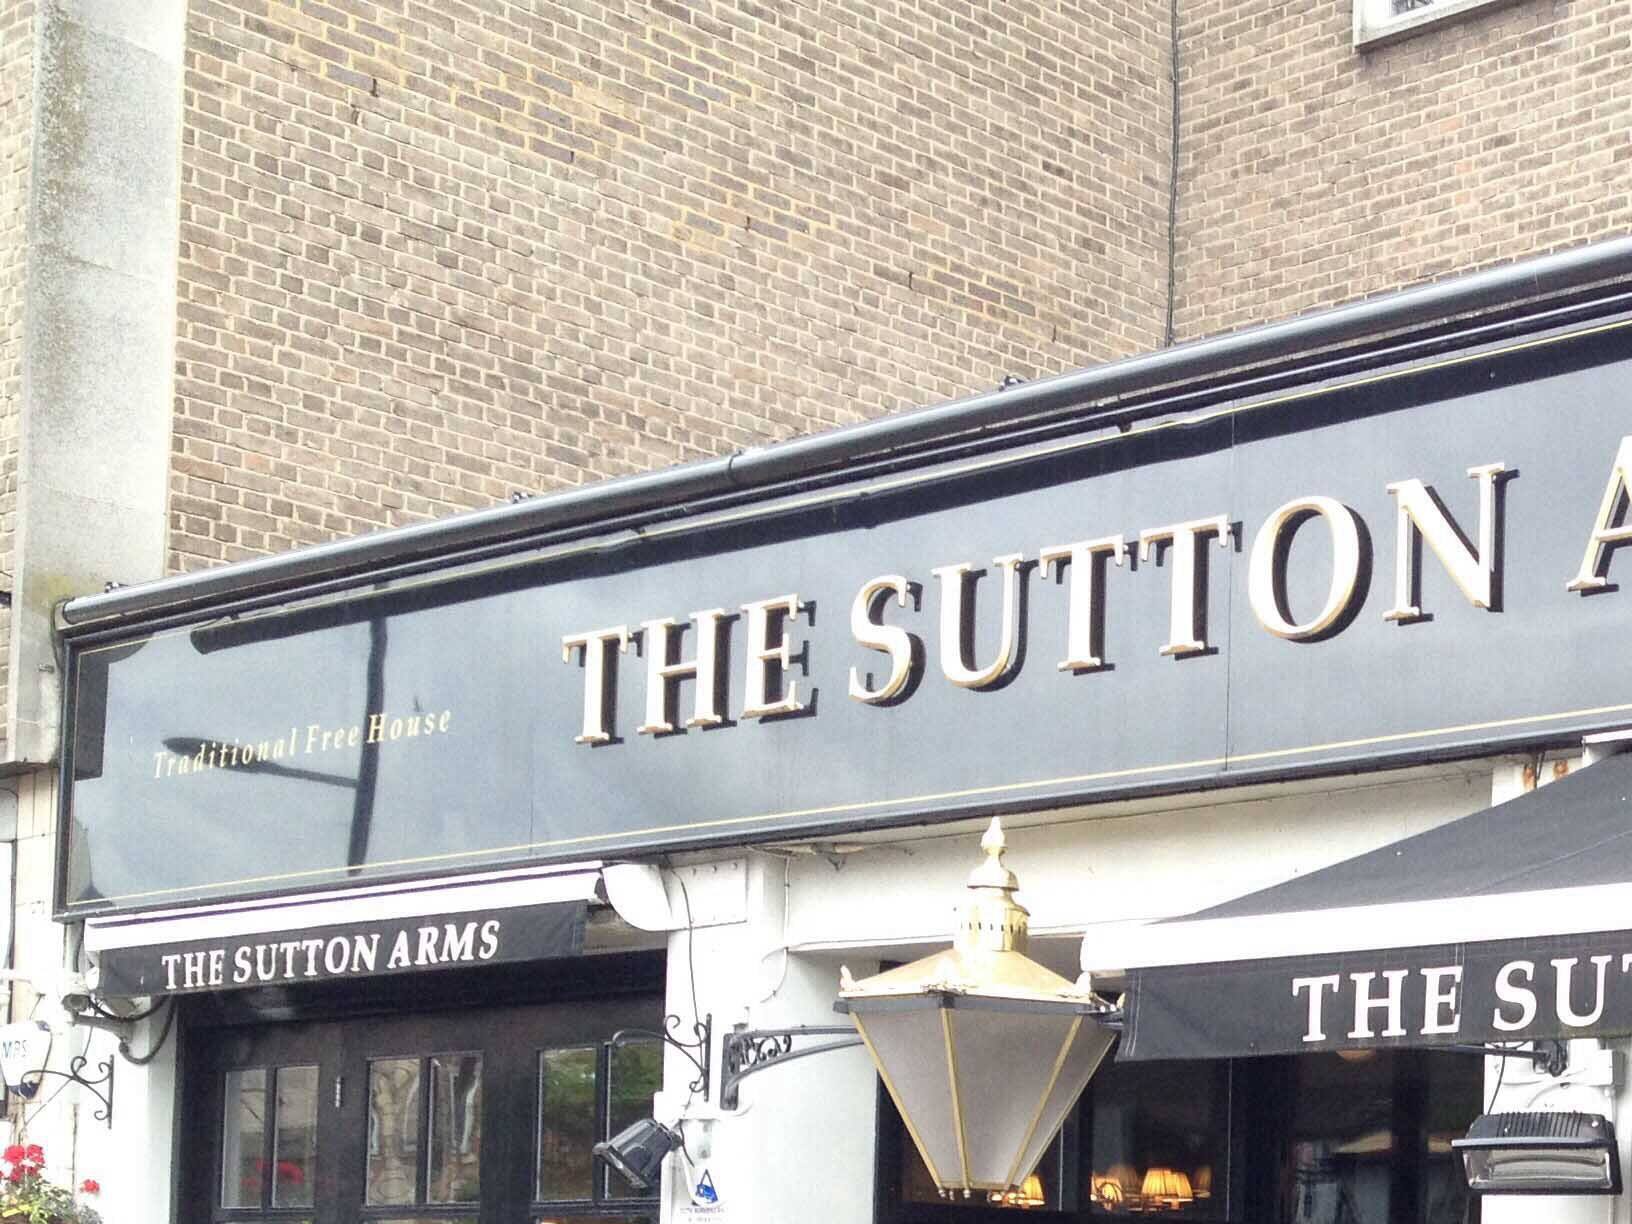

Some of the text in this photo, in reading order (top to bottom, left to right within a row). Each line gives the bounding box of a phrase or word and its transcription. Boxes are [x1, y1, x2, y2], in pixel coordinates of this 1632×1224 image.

[561, 593, 808, 746] THE
[849, 461, 1507, 706] SUTTON
[153, 710, 452, 779] Traditional Free House
[162, 920, 501, 990] THE SUTTON ARMS
[1293, 966, 1463, 1042] THE
